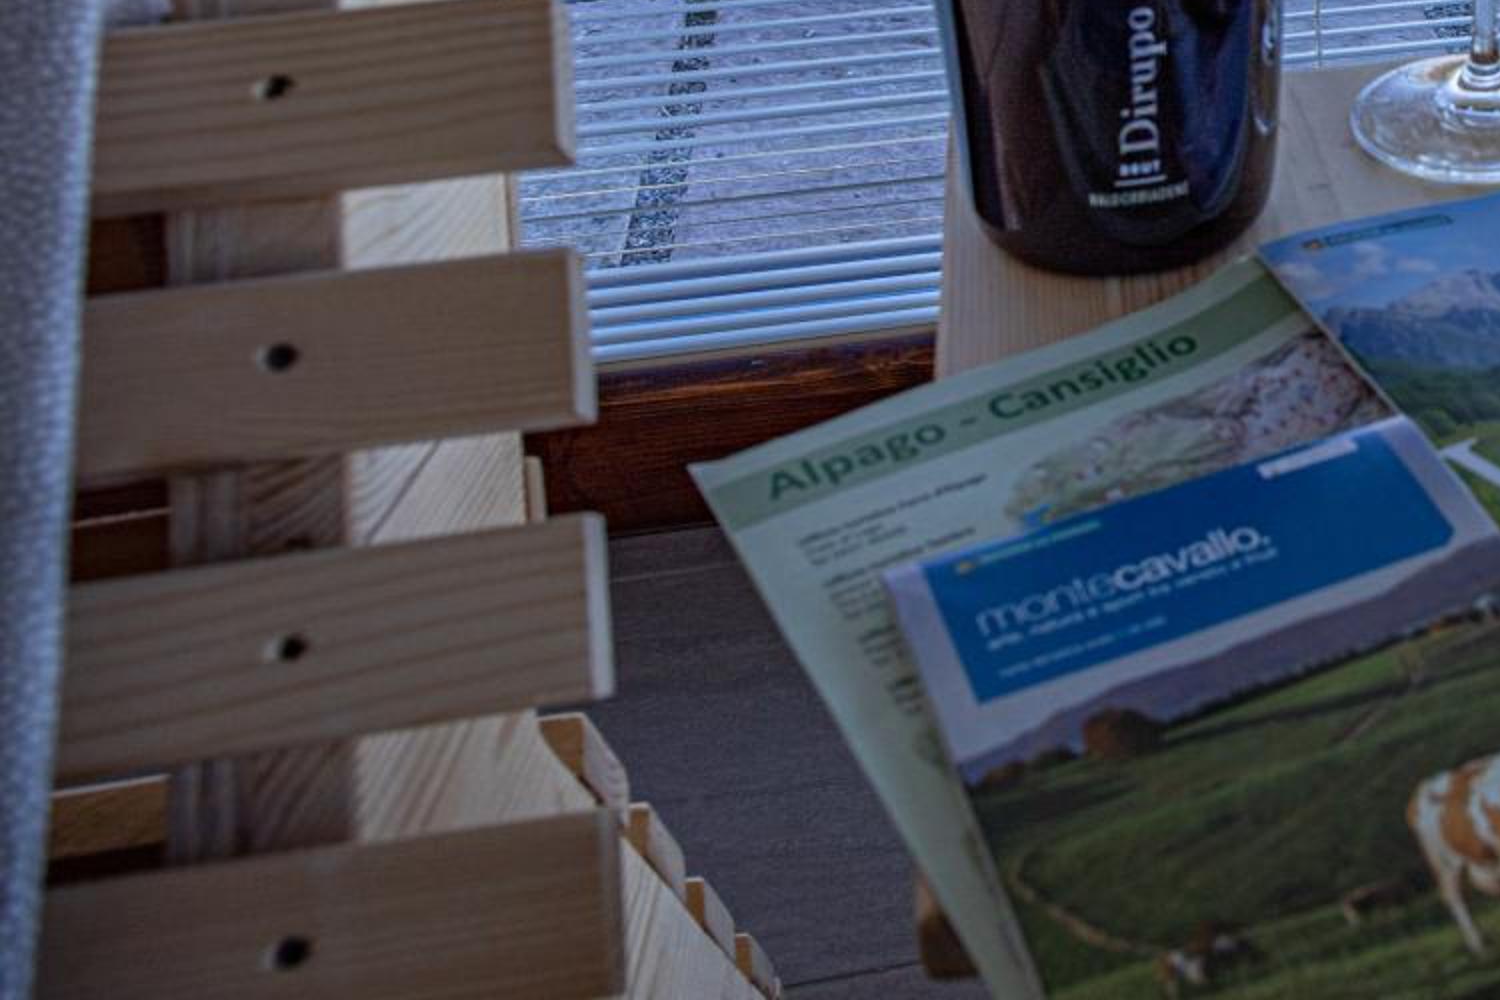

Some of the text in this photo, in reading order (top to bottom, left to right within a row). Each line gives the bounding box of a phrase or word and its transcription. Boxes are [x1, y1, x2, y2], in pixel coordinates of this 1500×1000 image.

[1119, 5, 1167, 155] Dirupo
[769, 419, 946, 502] Alpago
[988, 330, 1199, 421] Cansiglio
